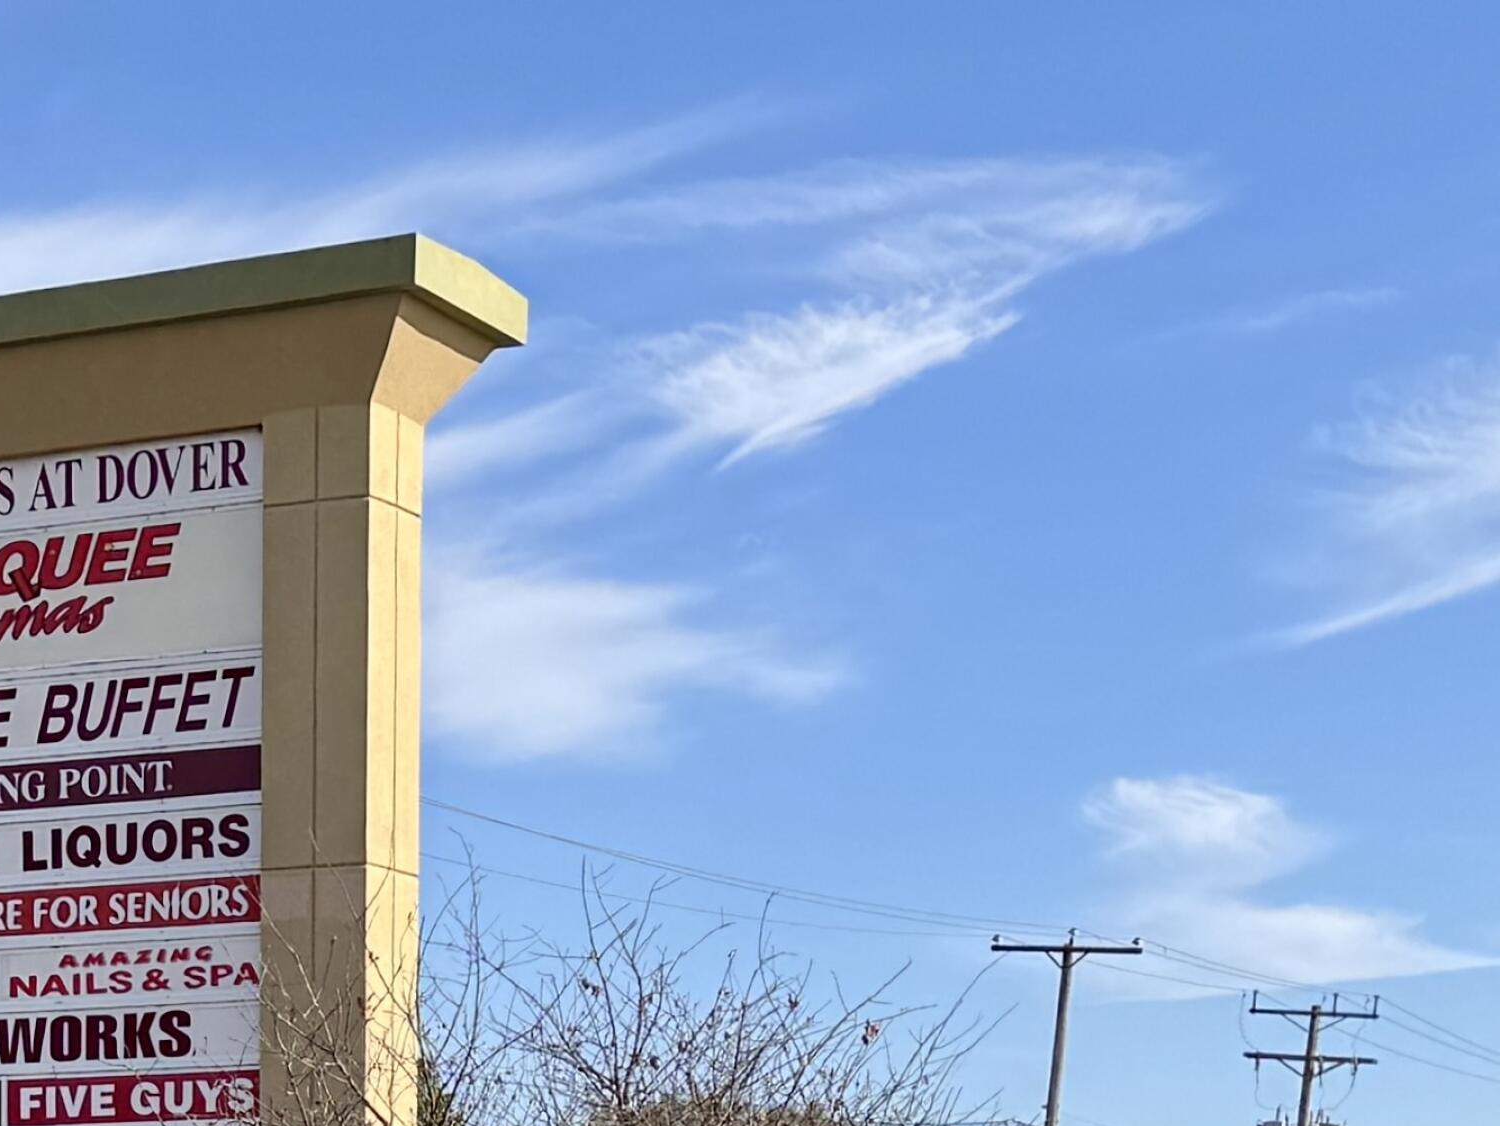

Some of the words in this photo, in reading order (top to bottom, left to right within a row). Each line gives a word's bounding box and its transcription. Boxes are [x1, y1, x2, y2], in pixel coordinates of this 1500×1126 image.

[29, 459, 84, 512] AT
[98, 439, 249, 503] DOVER
[37, 667, 256, 744] BUFFET
[58, 760, 174, 799] POINT
[22, 814, 251, 872] LIQUORS
[33, 894, 100, 929] FOR
[109, 883, 251, 925] SENIORS
[58, 946, 214, 969] AMAZING
[9, 970, 134, 998] NAILS
[141, 968, 171, 991] &
[183, 962, 260, 990] SPA
[19, 1084, 116, 1120] FIVE
[130, 1077, 255, 1116] GUYS
